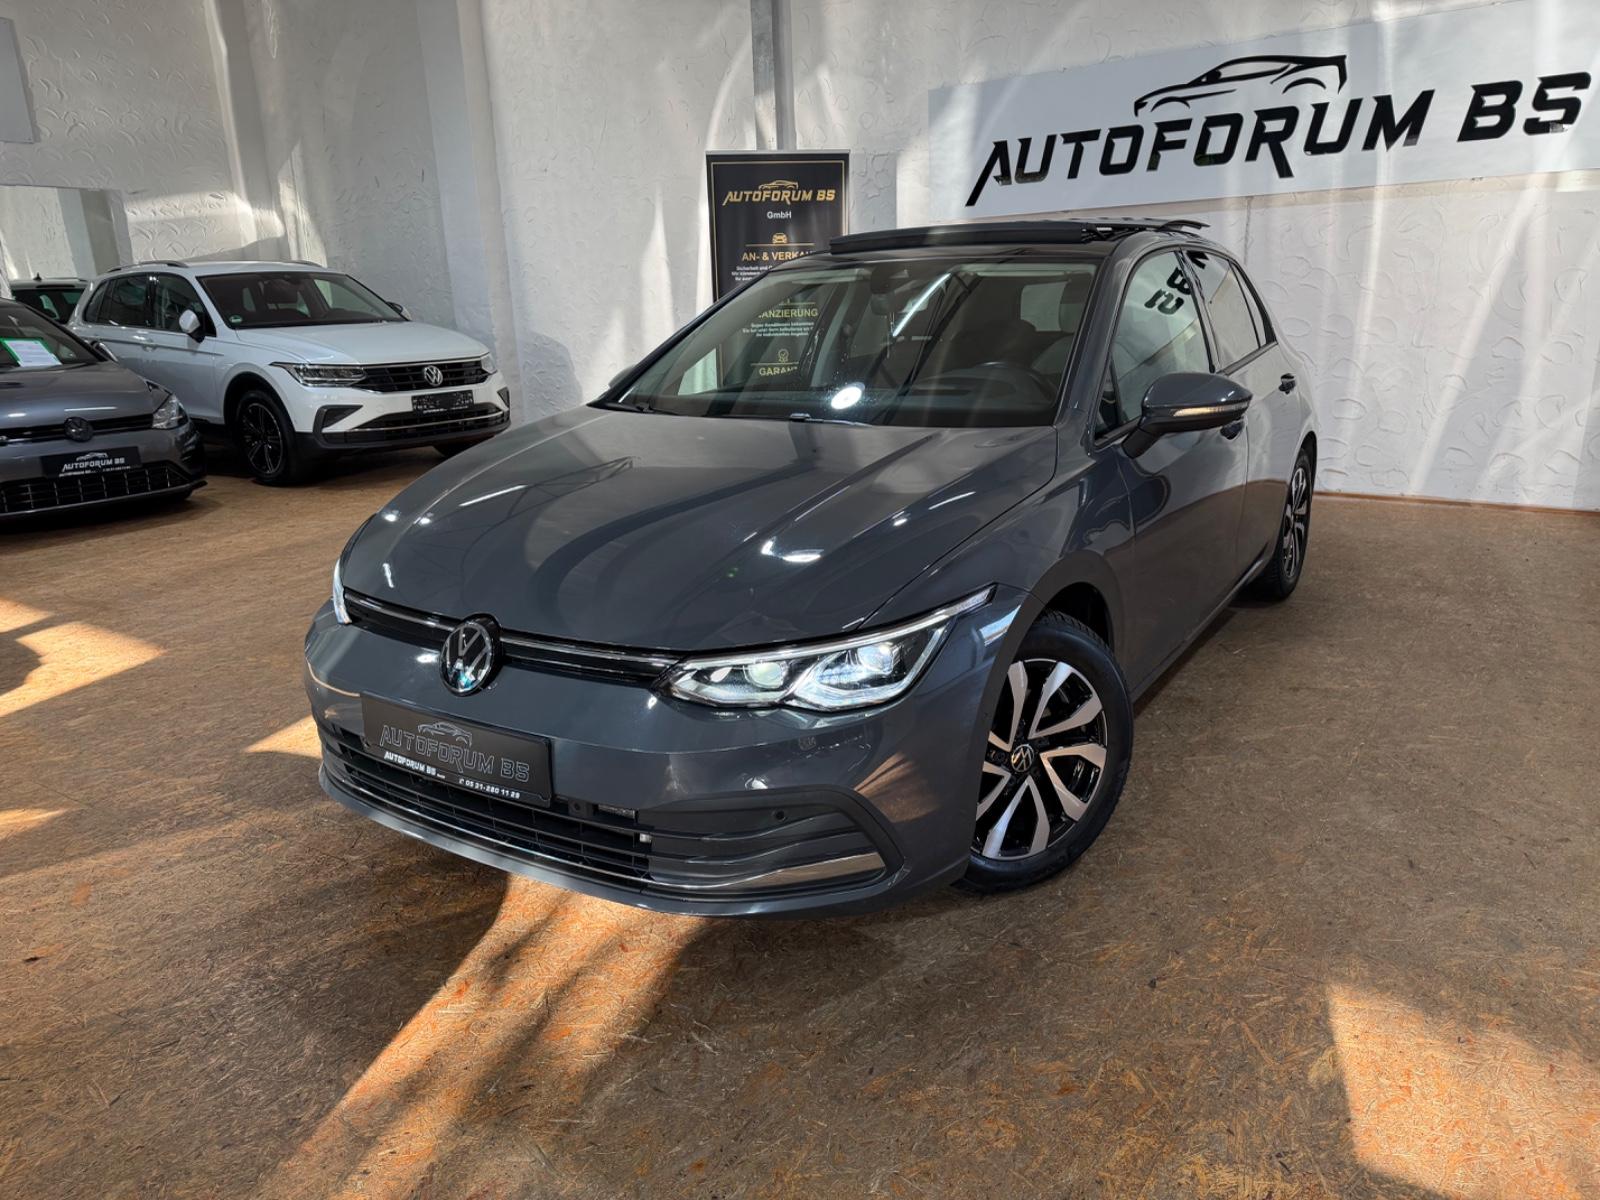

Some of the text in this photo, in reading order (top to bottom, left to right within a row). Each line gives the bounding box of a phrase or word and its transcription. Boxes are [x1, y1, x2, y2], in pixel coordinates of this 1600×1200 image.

[965, 72, 1592, 207] AUTOFORUM BS
[722, 189, 836, 206] AUTOFORUM BS
[766, 211, 792, 219] GmbH
[742, 251, 816, 261] AN- & VERK
[758, 308, 818, 318] ANZIERUNG
[62, 459, 112, 472] AUTOFORUM
[380, 724, 529, 783] AUTOFORUM BS
[384, 751, 425, 772] AUTOFORUM
